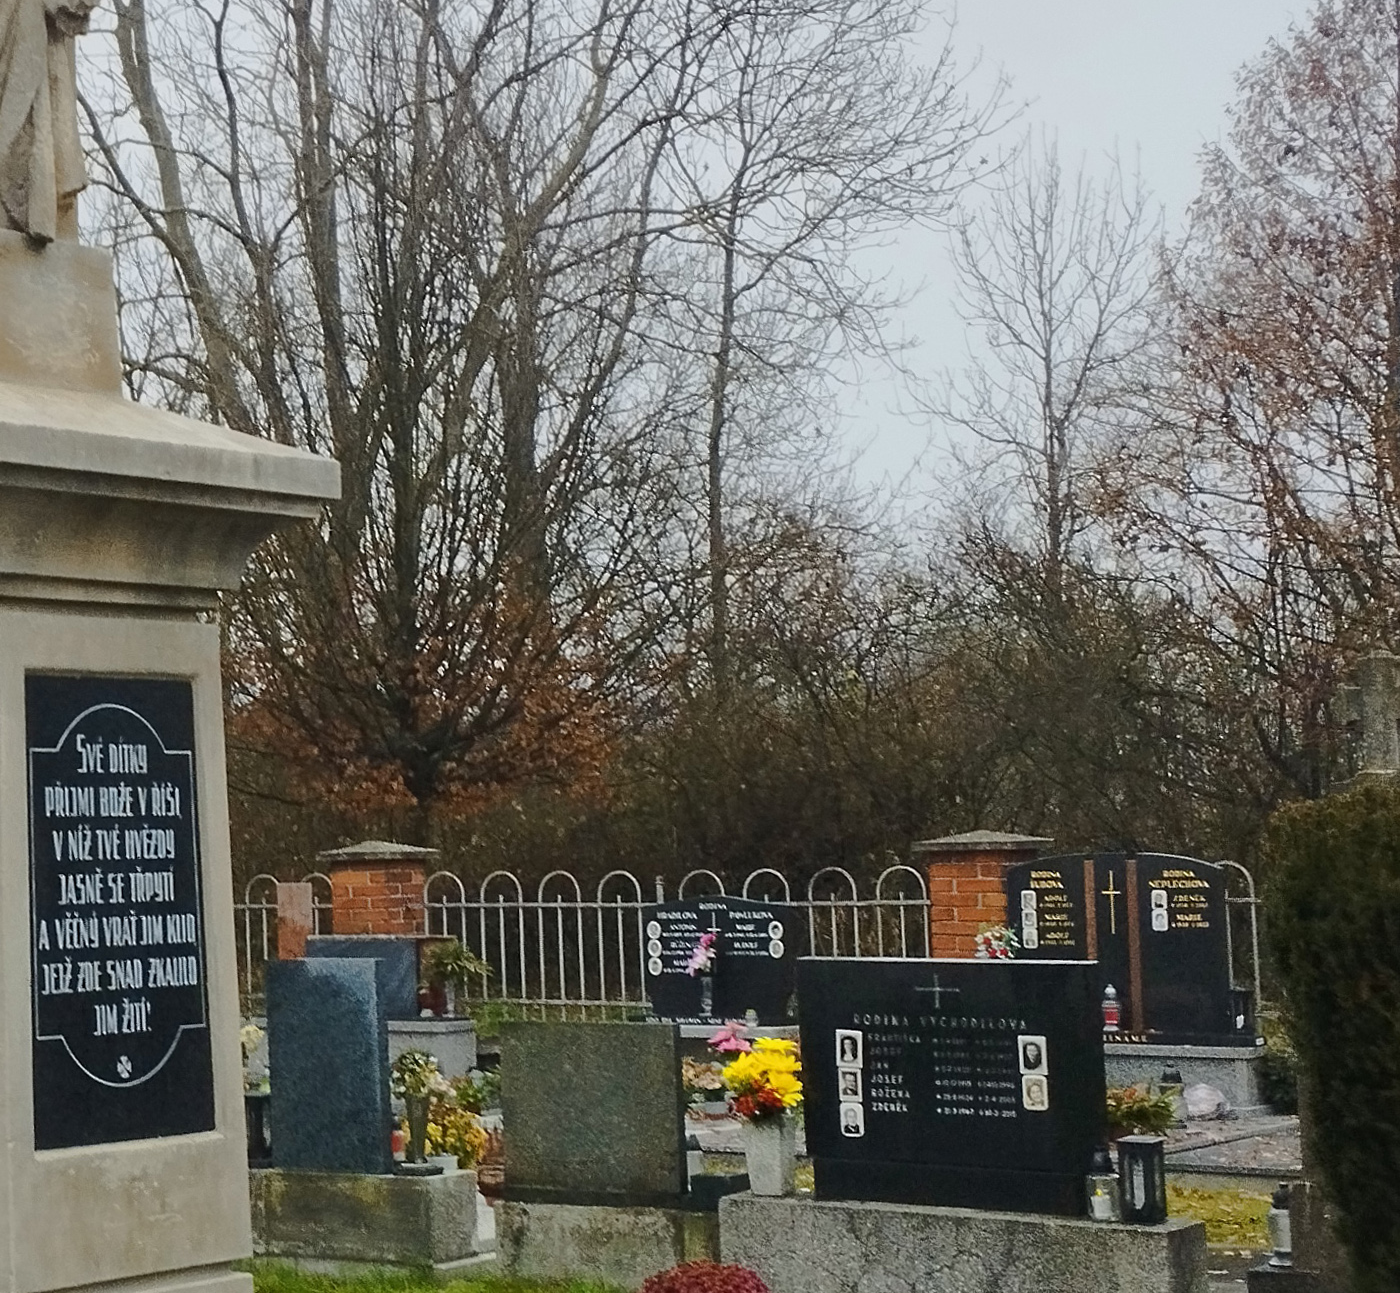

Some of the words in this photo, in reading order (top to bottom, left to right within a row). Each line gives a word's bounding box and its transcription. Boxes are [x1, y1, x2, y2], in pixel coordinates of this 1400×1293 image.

[44, 781, 95, 817] PŘIJMI
[100, 781, 134, 817] BOŽE
[137, 786, 147, 816] V
[52, 829, 63, 861] V
[67, 823, 93, 861] NÍŽ
[96, 823, 121, 860] TVÉ
[125, 823, 175, 859] HVĚZDY
[58, 866, 105, 905] JASNĚ
[107, 872, 125, 904] SE
[128, 865, 175, 903] TŘPYTÍ
[1162, 869, 1196, 878] RODINA
[38, 919, 50, 951] A
[54, 910, 99, 950] VĚČNÝ
[139, 915, 164, 946] JIM
[41, 956, 74, 995] JEJŽ
[77, 960, 102, 993] ZDE
[106, 959, 143, 991] SNAD
[93, 1004, 118, 1036] JIM
[853, 1013, 909, 1026] RODINA
[919, 1015, 1027, 1031] VYCHODILOVA
[871, 1074, 903, 1084] JOSEF
